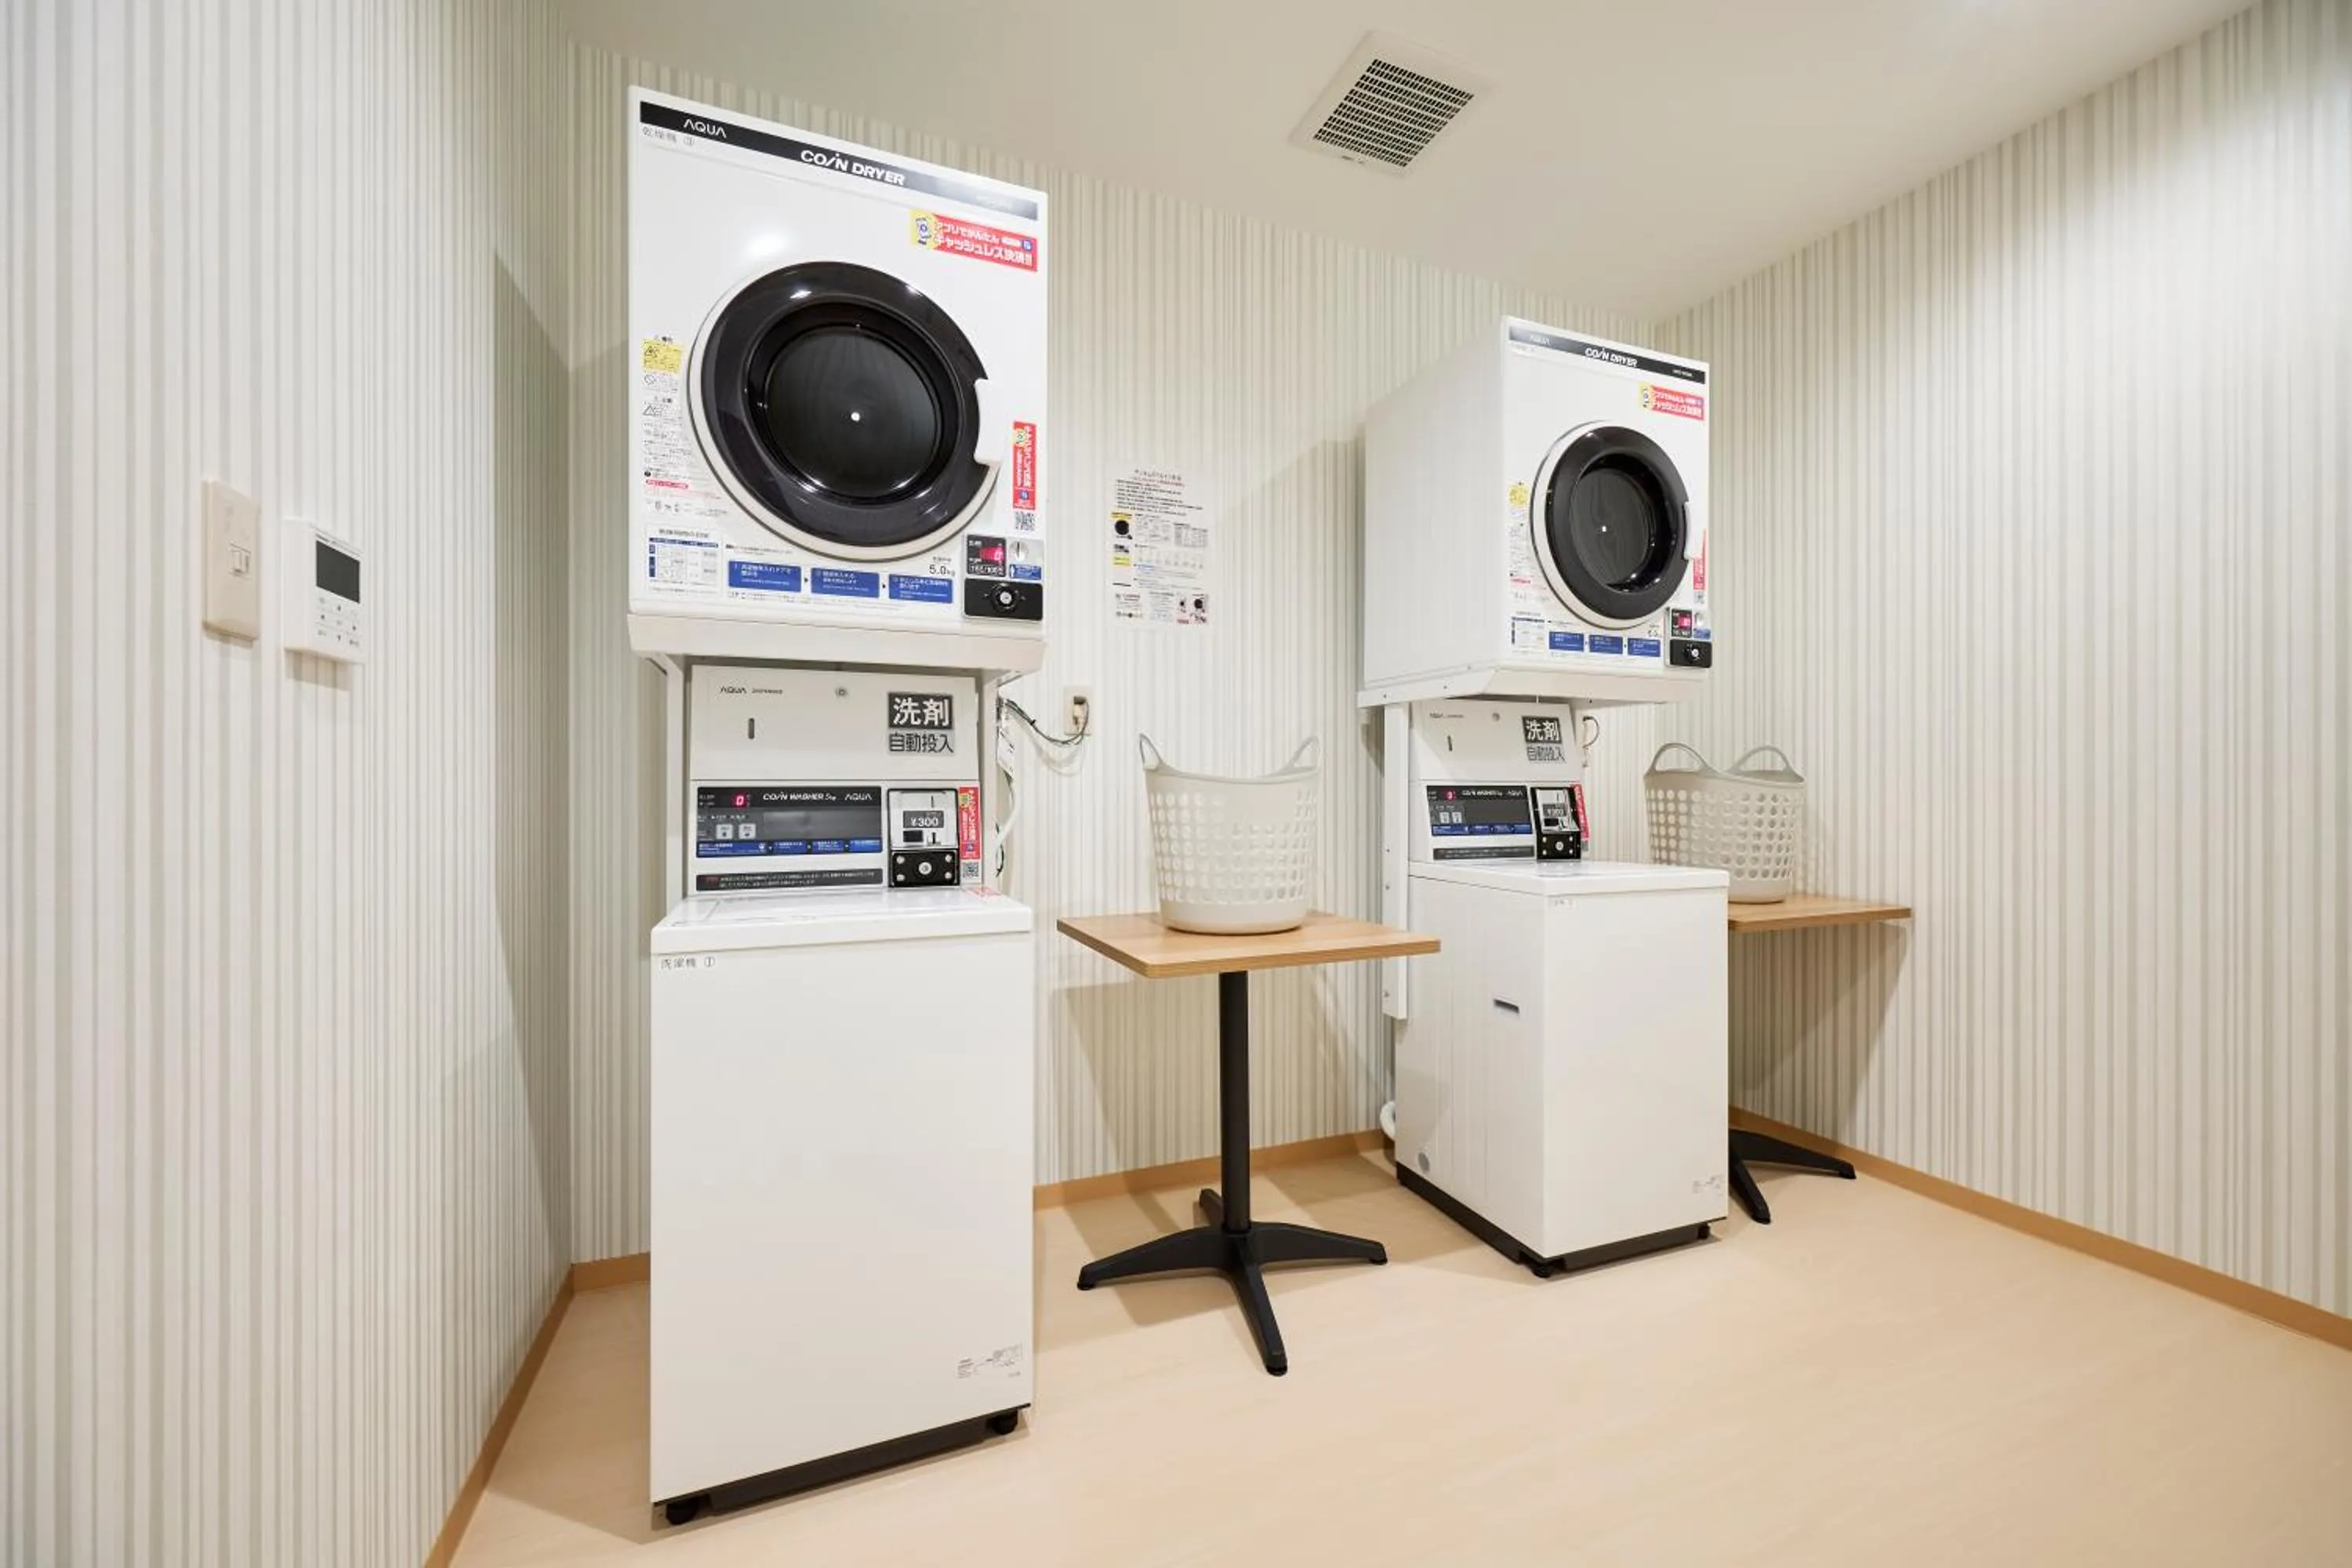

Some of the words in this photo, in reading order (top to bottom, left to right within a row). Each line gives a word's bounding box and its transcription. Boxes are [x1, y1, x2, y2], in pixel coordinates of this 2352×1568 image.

[684, 119, 727, 138] AQUA
[851, 162, 905, 185] DRYER
[893, 697, 949, 726] 洗剤
[1526, 720, 1559, 740] 洗剤
[890, 732, 953, 753] 自動投入
[736, 796, 744, 805] 0
